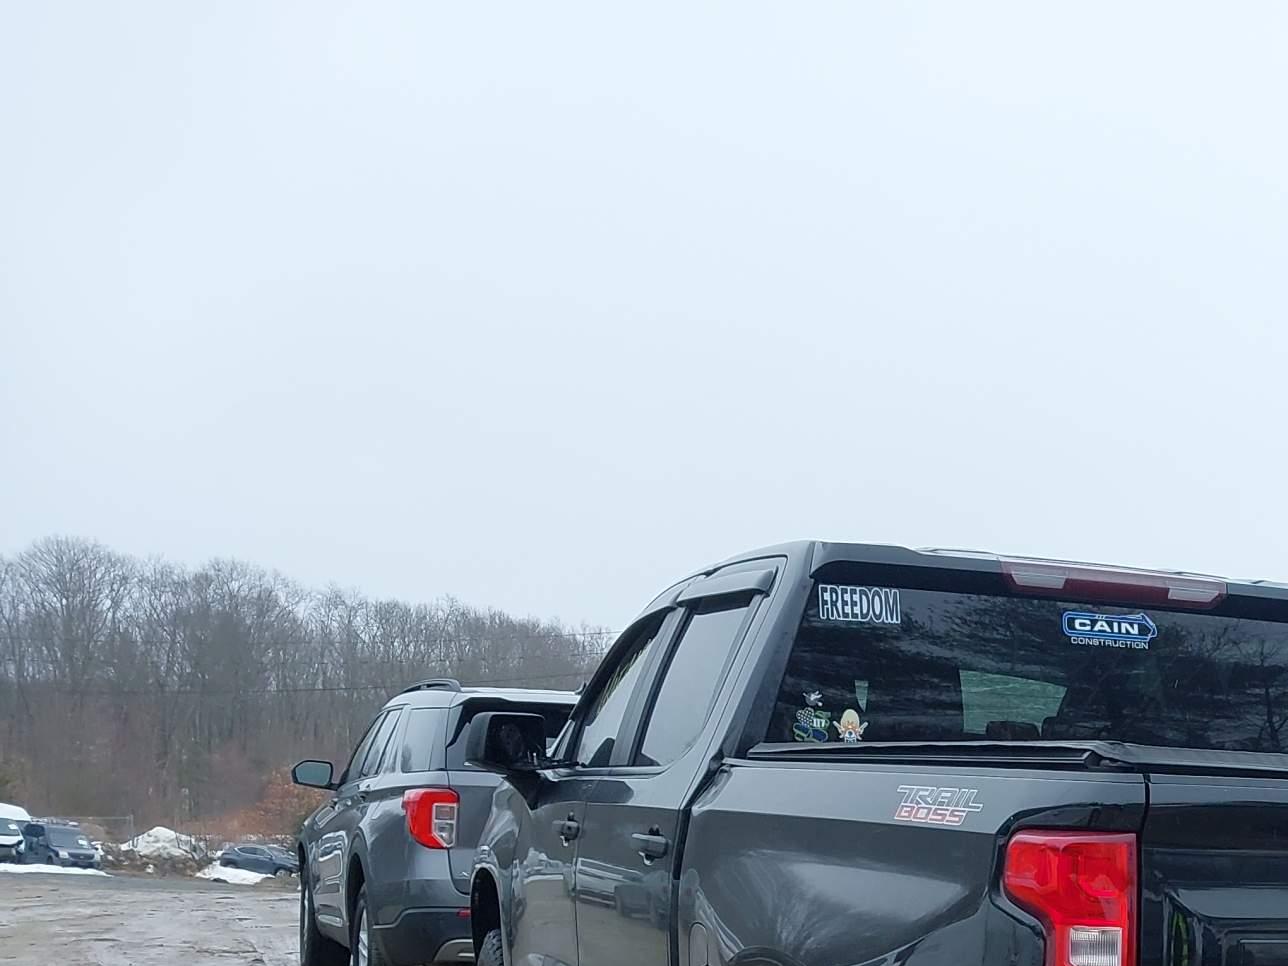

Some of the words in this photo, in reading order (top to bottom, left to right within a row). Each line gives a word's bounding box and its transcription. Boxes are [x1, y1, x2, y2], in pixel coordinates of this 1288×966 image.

[818, 584, 901, 624] FREEDOM
[1074, 618, 1139, 635] CAIN
[1070, 636, 1149, 650] CONSTRUCTION
[896, 785, 984, 812] TRAIL
[894, 803, 968, 826] BOSS
